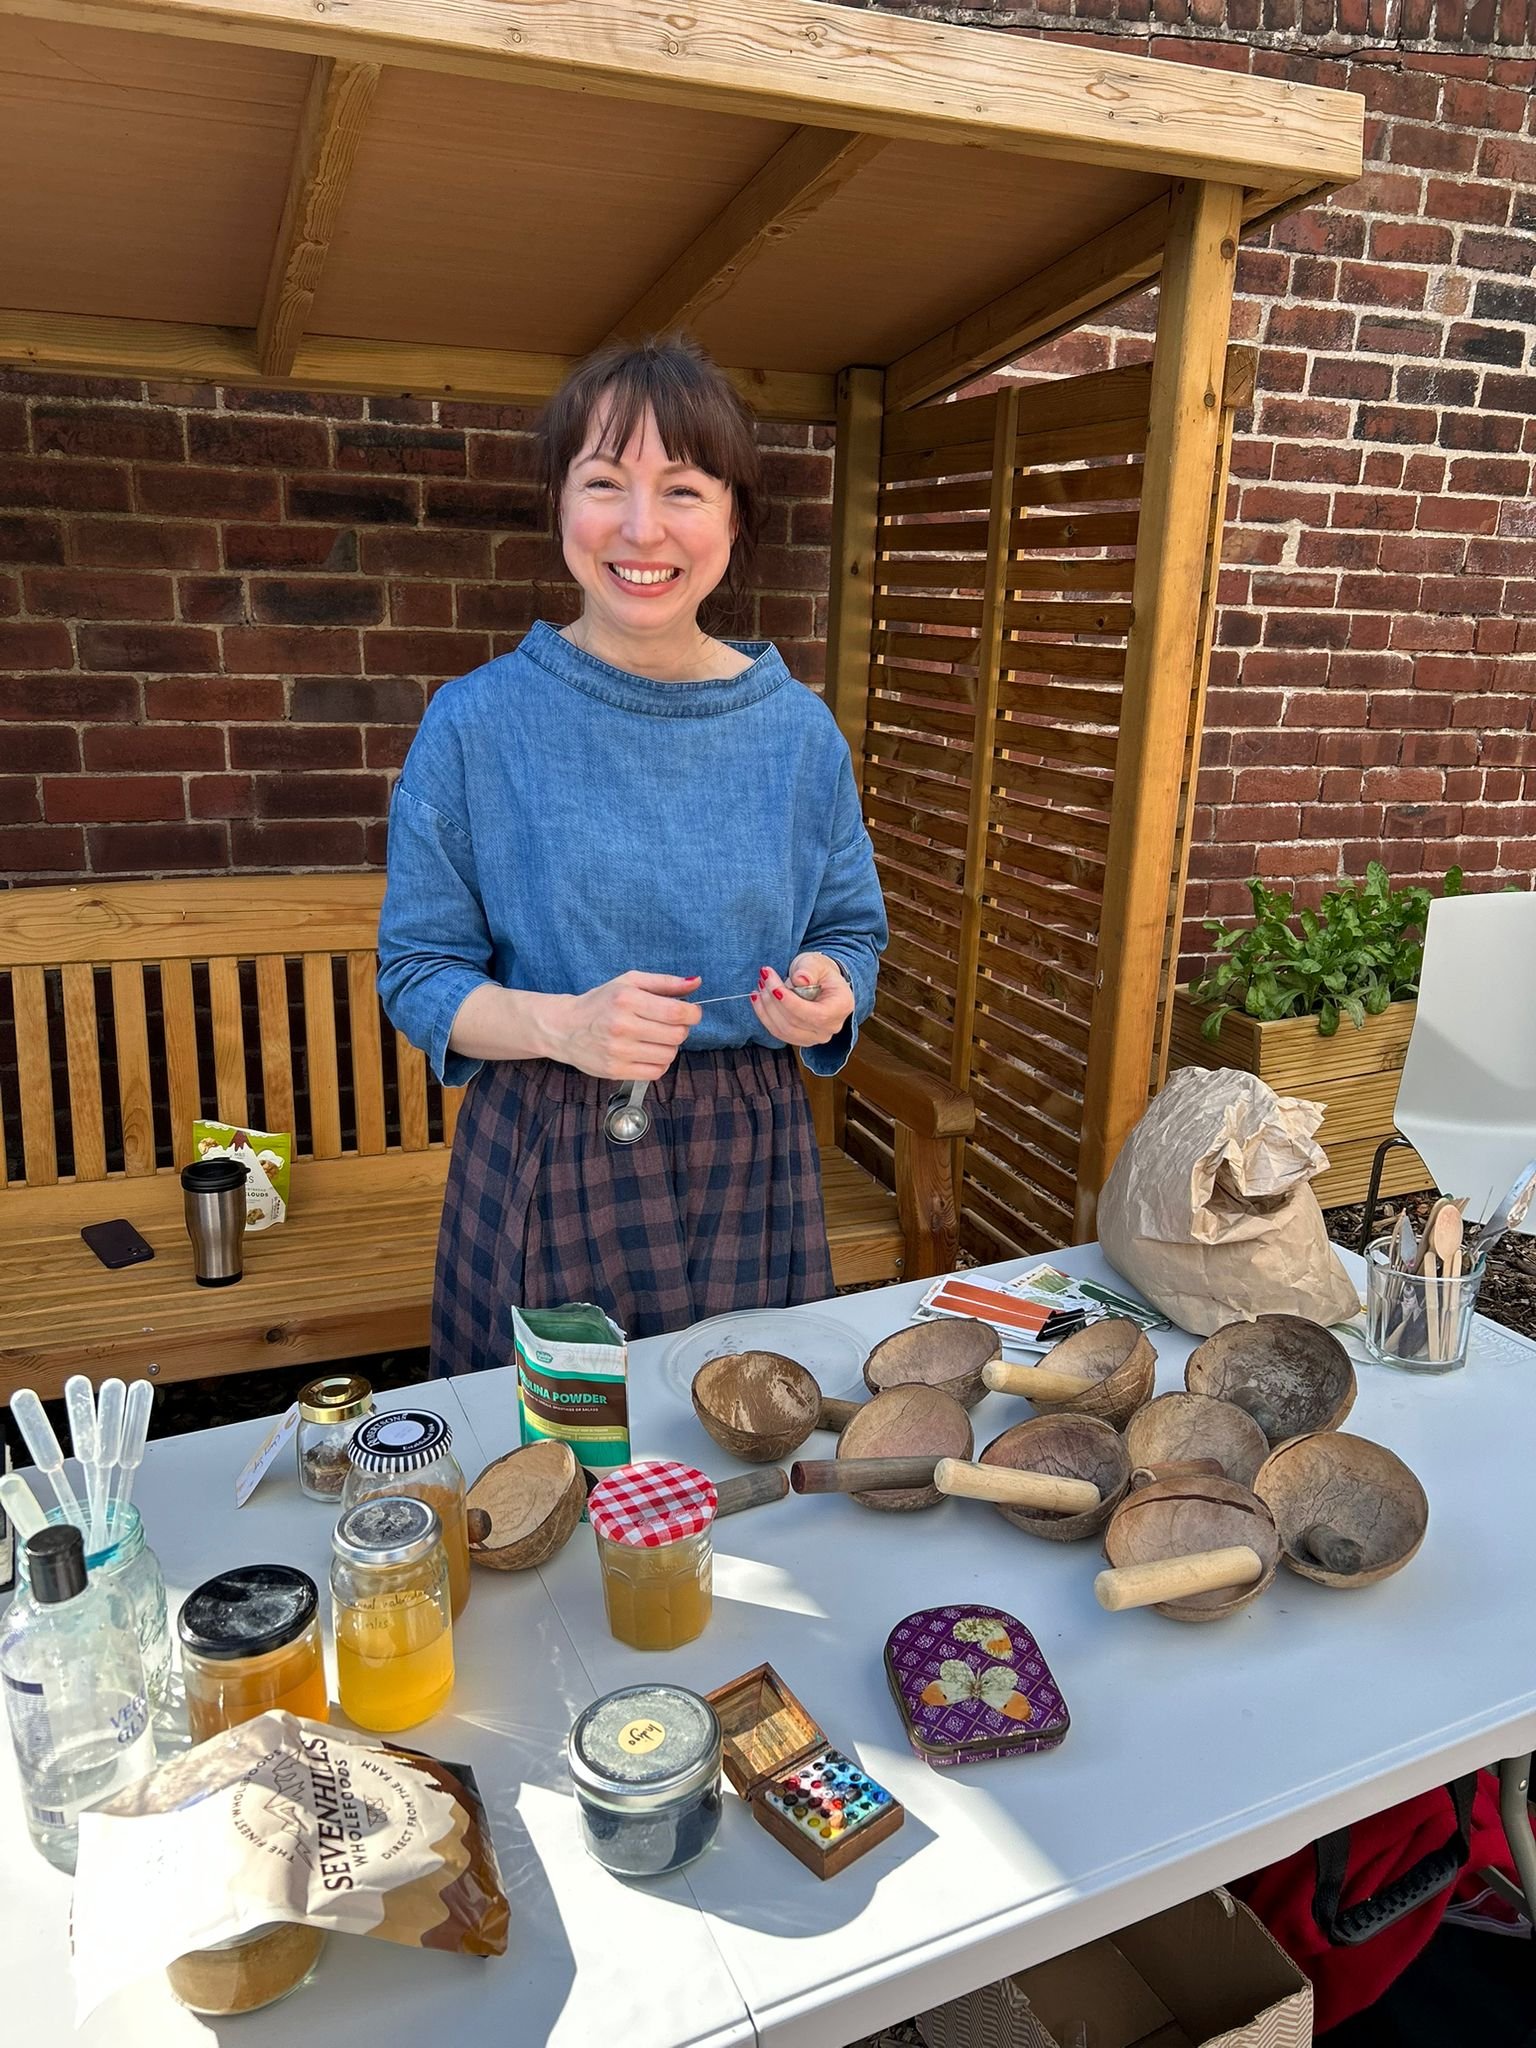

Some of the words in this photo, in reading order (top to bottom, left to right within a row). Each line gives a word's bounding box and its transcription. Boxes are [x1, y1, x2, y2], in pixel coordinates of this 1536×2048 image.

[552, 1391, 608, 1405] POWDER
[628, 1723, 663, 1746] Indigo
[231, 1749, 282, 1817] WHOLEFOODS
[360, 1759, 393, 1782] FARM
[391, 1781, 410, 1800] THE
[301, 1738, 354, 1891] SEVENHILLS
[335, 1759, 369, 1867] WHOLEFOODS
[405, 1800, 417, 1828] FROM
[235, 1820, 267, 1849] FINEST
[381, 1829, 414, 1860] DIRECT
[270, 1845, 296, 1864] THE
